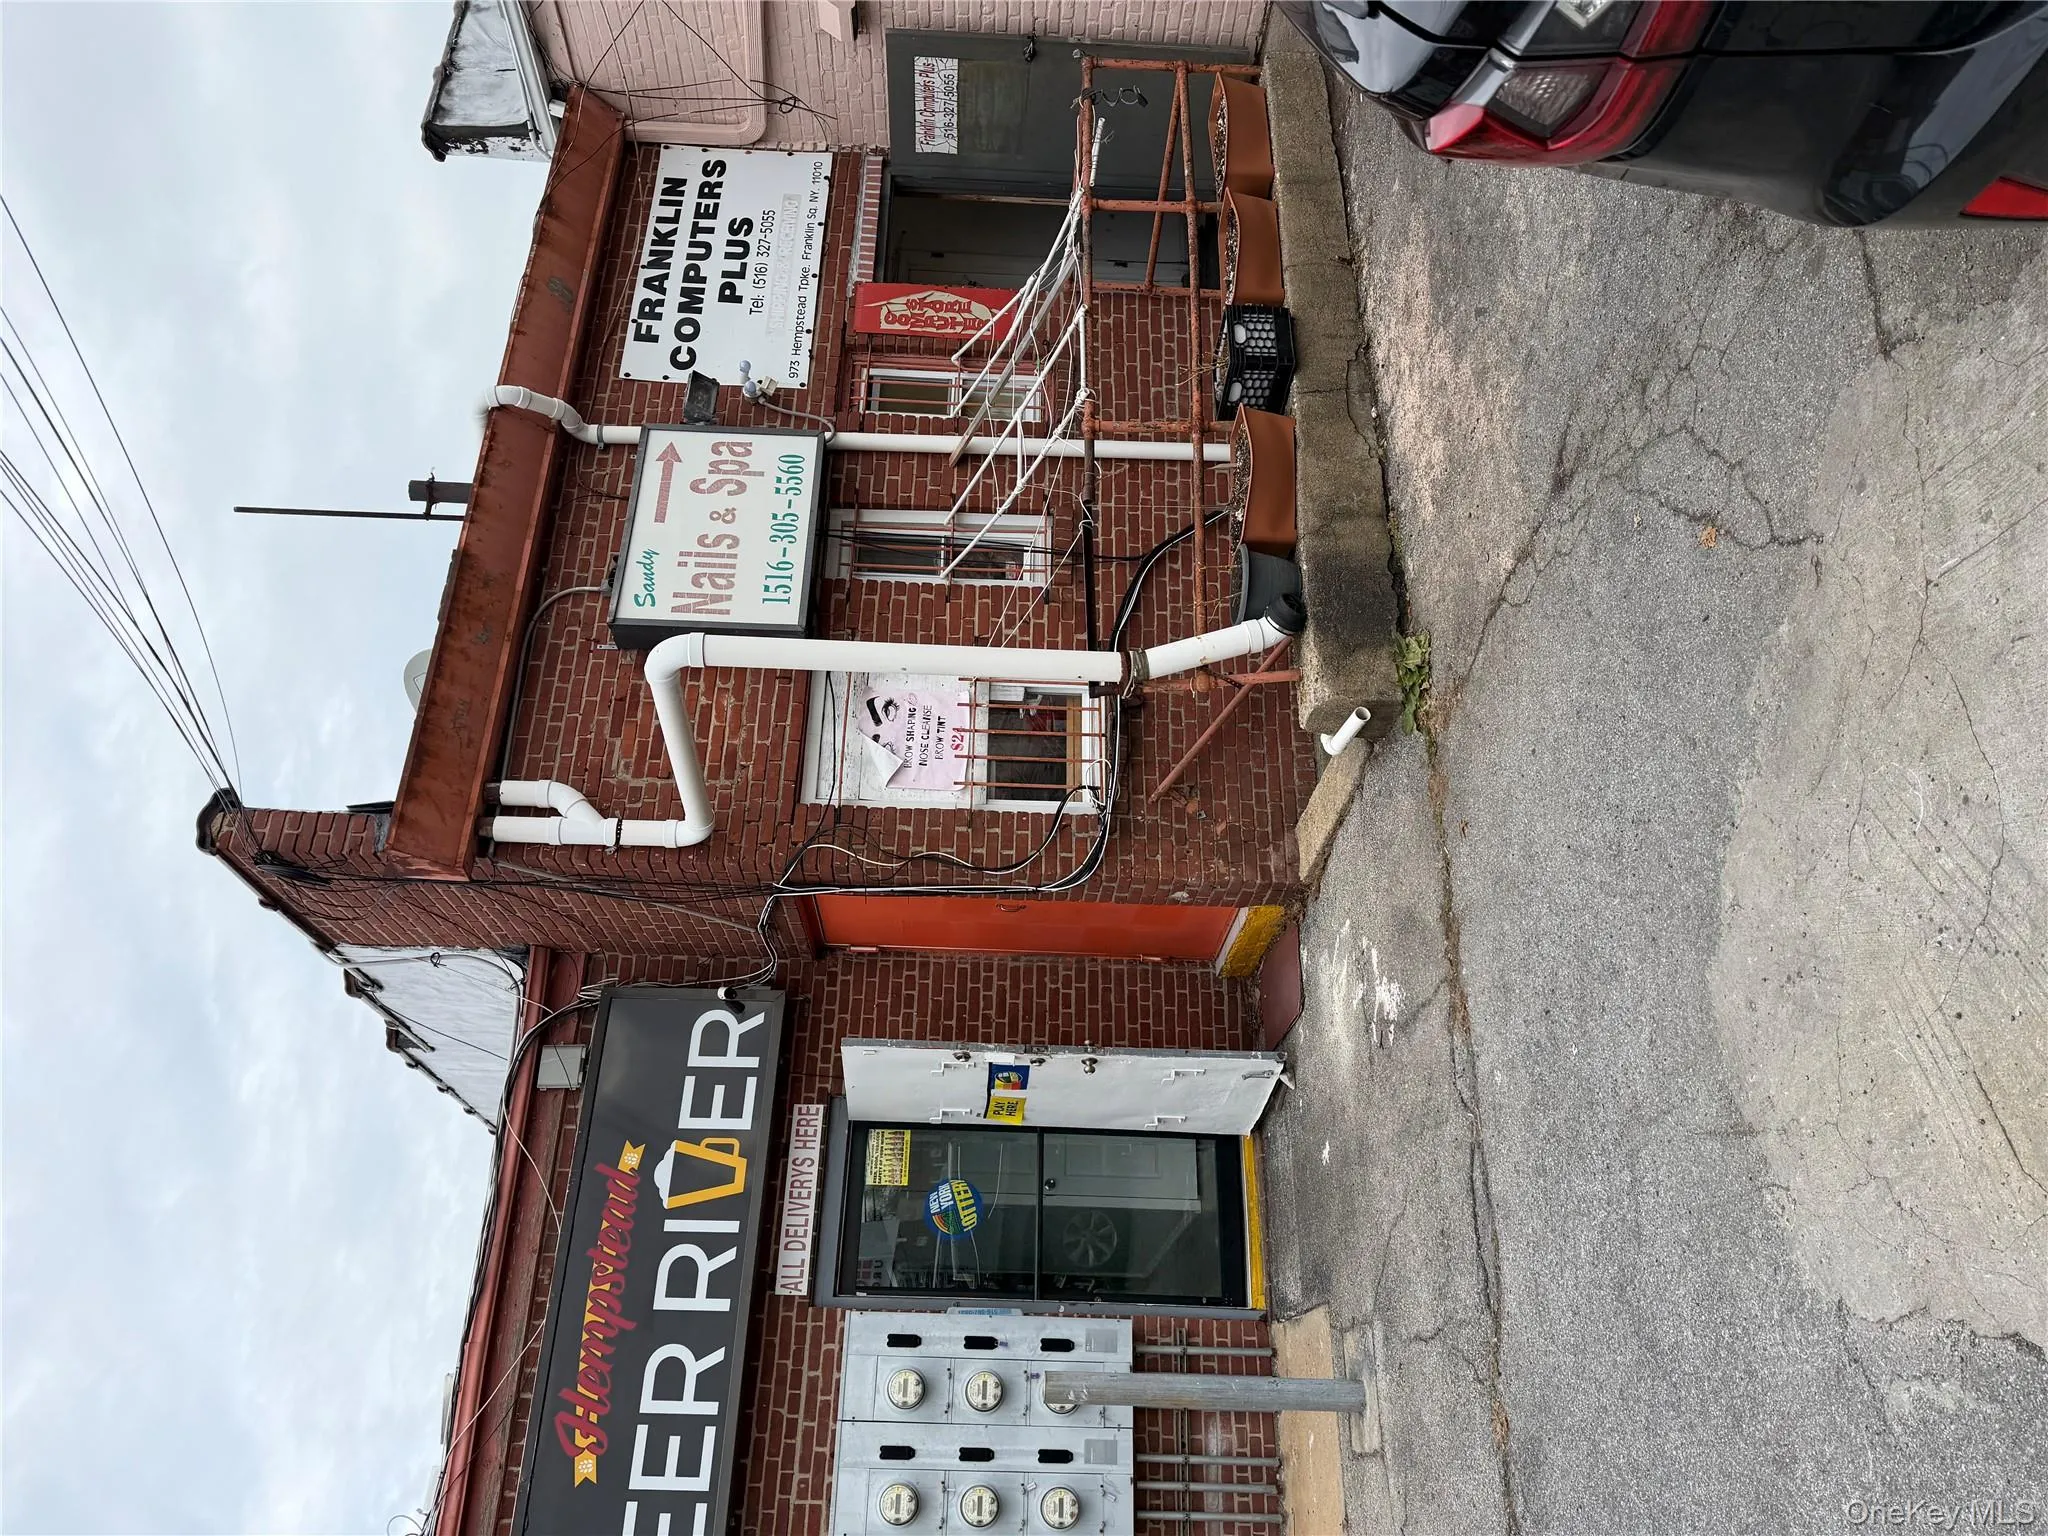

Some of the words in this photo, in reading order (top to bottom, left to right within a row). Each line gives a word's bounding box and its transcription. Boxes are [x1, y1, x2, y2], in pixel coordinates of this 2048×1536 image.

[919, 62, 935, 78] Plus
[944, 74, 955, 139] 516-327-5055
[920, 119, 936, 145] Franklin
[812, 161, 823, 185] 11010
[808, 206, 818, 219] Sq.
[810, 188, 820, 202] NY.
[756, 209, 776, 258] 327-5055
[801, 222, 815, 261] Franklin
[633, 177, 688, 344] FRANKLIN
[669, 159, 727, 371] COMPUTERS
[717, 217, 753, 304] PLUS
[752, 262, 769, 289] (516)
[798, 264, 811, 292] Tpke.
[749, 295, 765, 315] Tel:
[791, 295, 807, 356] Hempstead
[788, 360, 800, 379] 973
[689, 441, 765, 496] Spa
[709, 507, 737, 524] &
[762, 454, 805, 605] 1516-305-5560
[633, 548, 659, 607] Sandy
[670, 532, 740, 616] Nails
[905, 707, 917, 742] SHAPING
[921, 705, 932, 740] CLEANSE
[936, 715, 946, 733] TINT
[903, 745, 913, 768] BROW
[918, 743, 929, 767] NOSE
[935, 736, 944, 760] BROW
[992, 1101, 1006, 1115] PLAY
[1005, 1101, 1019, 1116] HERE
[794, 1106, 820, 1150] HERE
[653, 1009, 765, 1311] RIVER
[783, 1157, 815, 1251] DELIVERYS
[929, 1191, 940, 1214] NEW
[938, 1182, 954, 1210] YORK
[949, 1180, 977, 1232] LOTTERY
[780, 1258, 806, 1293] ALL
[554, 1163, 638, 1458] Hempstead
